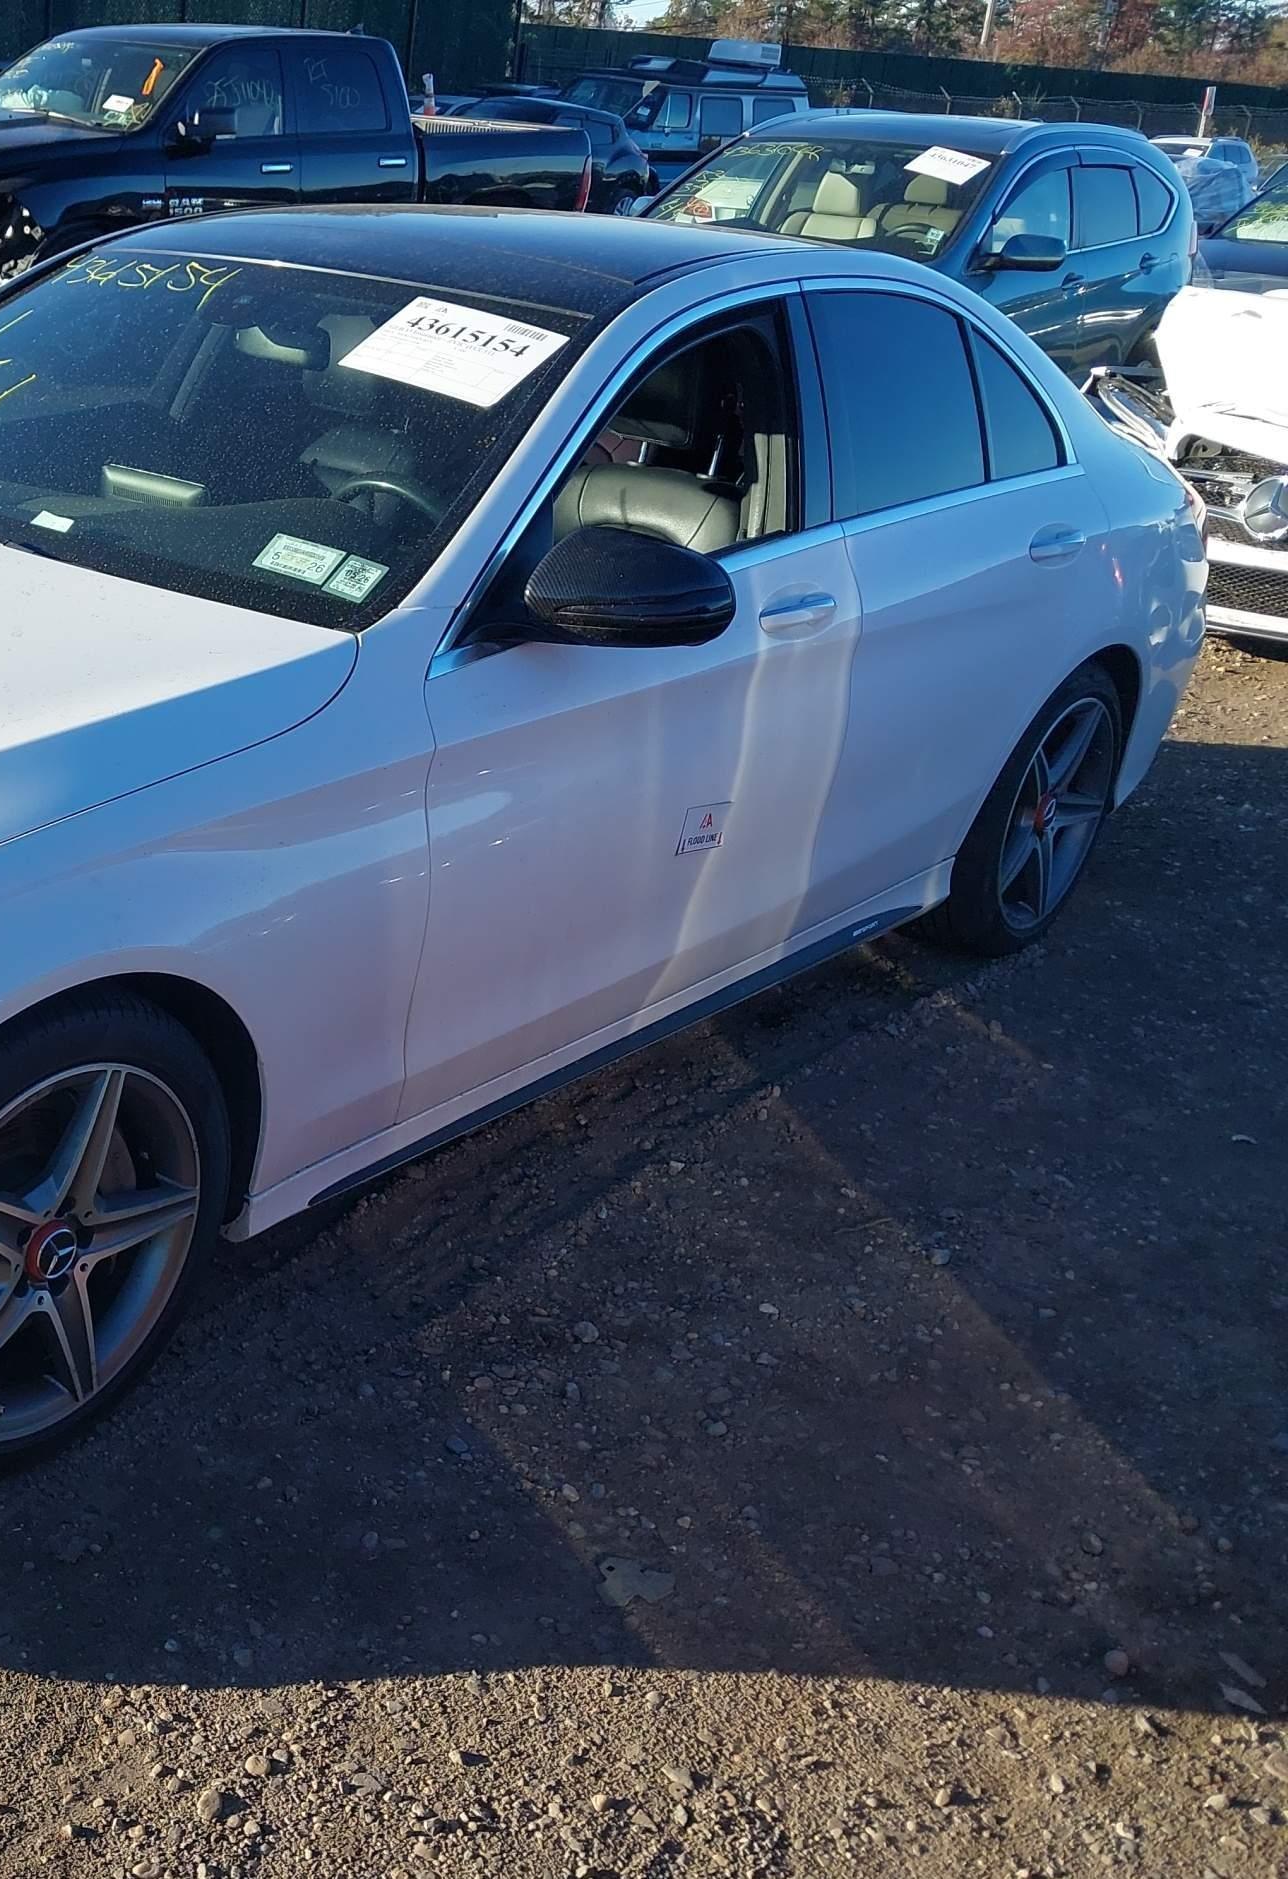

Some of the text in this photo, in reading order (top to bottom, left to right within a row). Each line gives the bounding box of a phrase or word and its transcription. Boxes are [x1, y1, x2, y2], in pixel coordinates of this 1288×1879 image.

[406, 315, 531, 358] 43615154
[306, 561, 326, 574] 26
[687, 834, 705, 846] FLOOD
